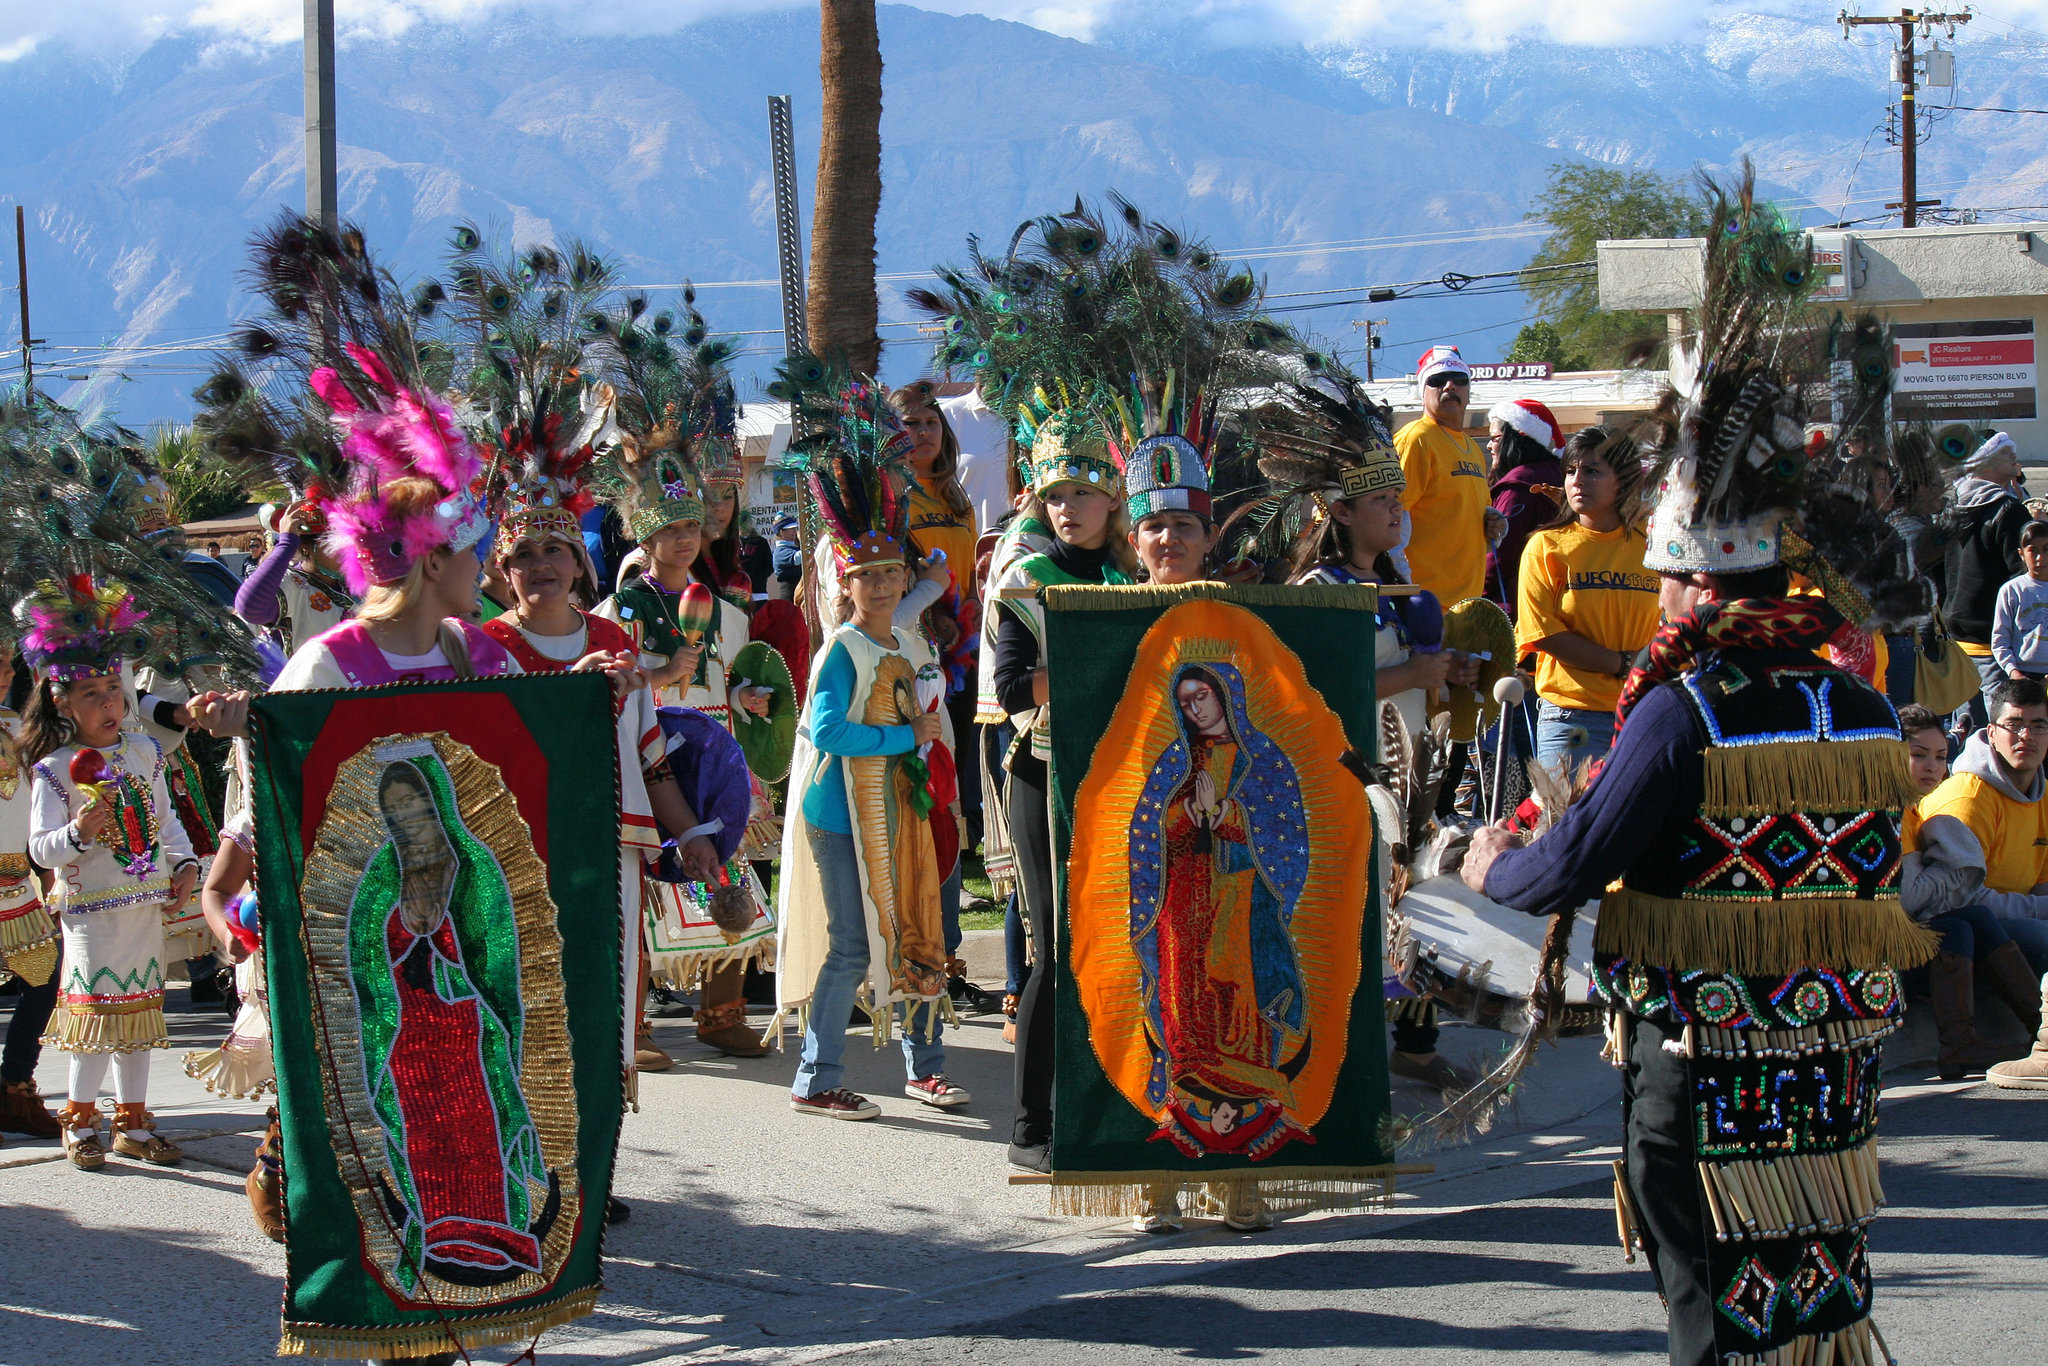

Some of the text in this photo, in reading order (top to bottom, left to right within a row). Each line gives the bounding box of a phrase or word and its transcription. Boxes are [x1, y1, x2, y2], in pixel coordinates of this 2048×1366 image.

[1943, 344, 1972, 353] Realtors
[1470, 365, 1547, 379] ORD OF LIFE
[1903, 375, 1934, 383] MOVING
[1948, 374, 1969, 382] 66070
[1971, 373, 2004, 381] PIERSON
[2006, 372, 2027, 380] BLVD
[1576, 570, 1627, 586] UFCW
